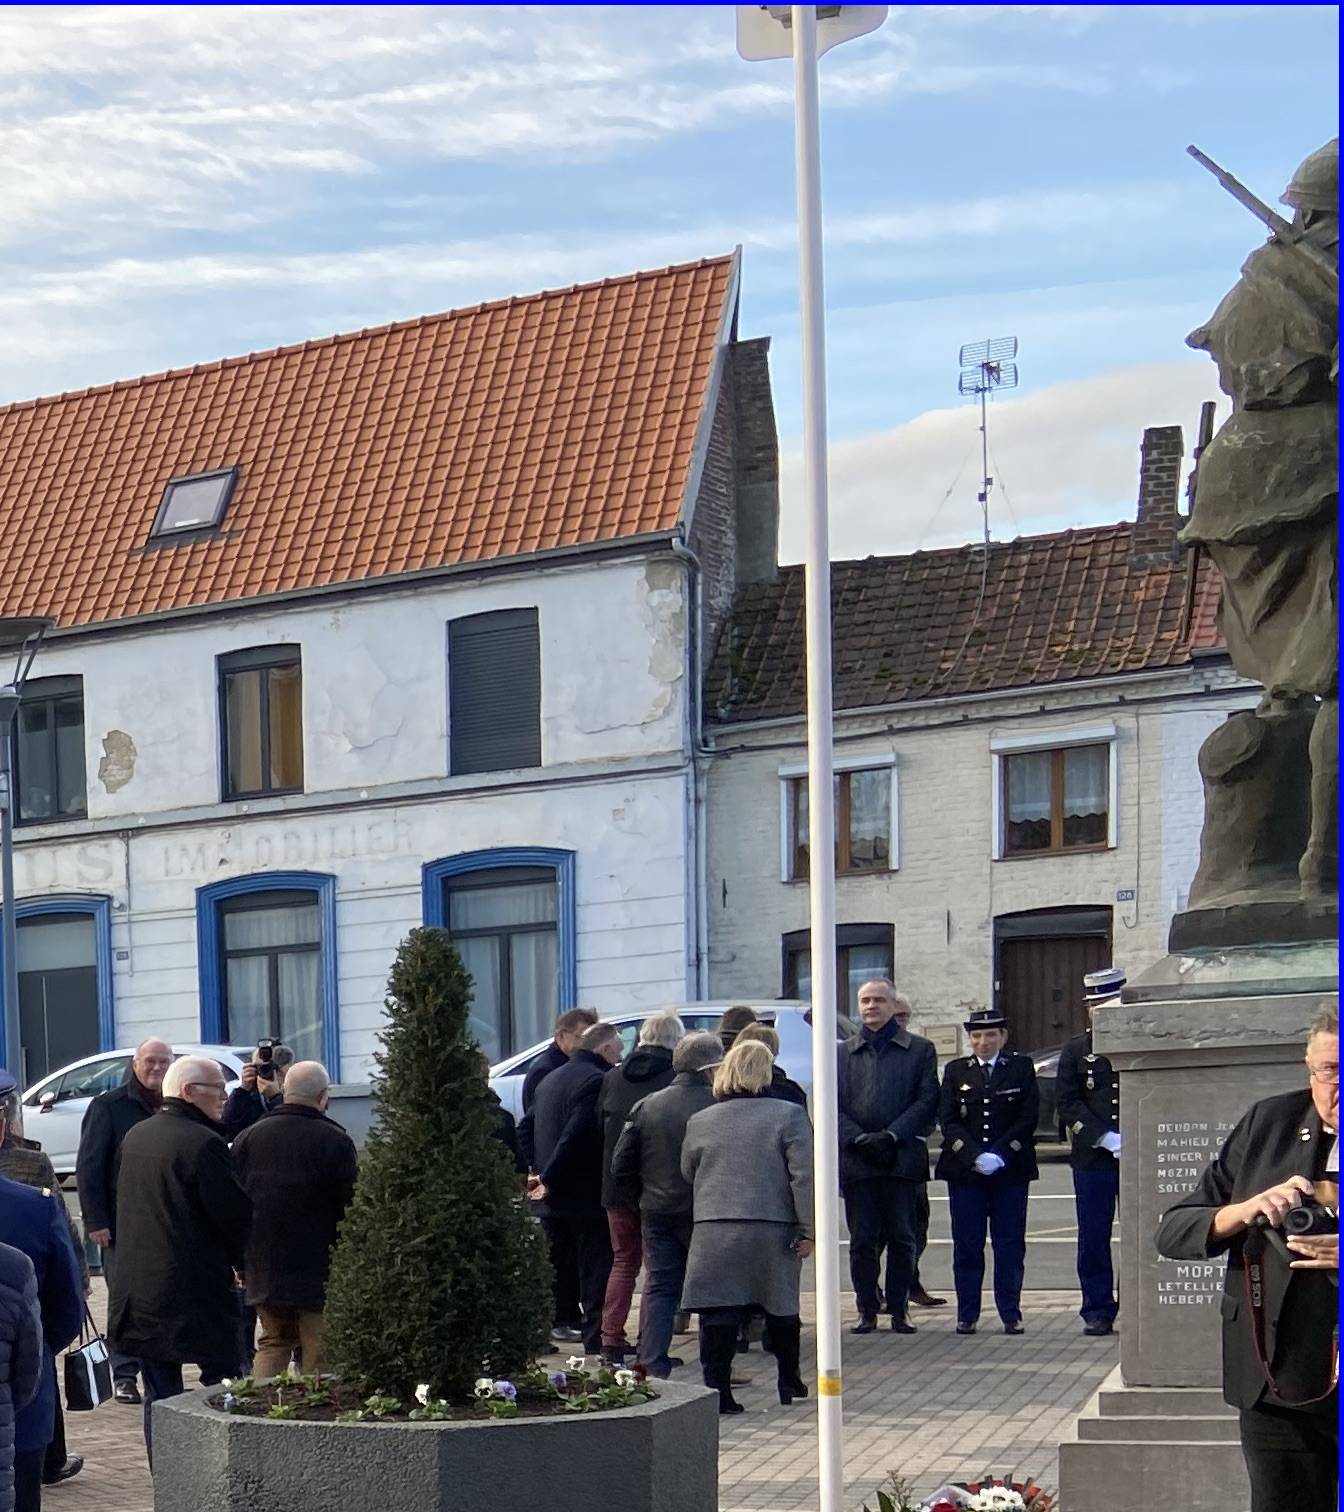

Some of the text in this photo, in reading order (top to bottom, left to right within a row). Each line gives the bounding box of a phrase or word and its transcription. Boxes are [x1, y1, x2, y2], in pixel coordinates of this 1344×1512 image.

[1215, 1121, 1235, 1131] JEA
[1157, 1137, 1210, 1148] MAHIEU
[1157, 1152, 1203, 1163] SINGER
[1158, 1282, 1224, 1292] LETELLIE
[1159, 1294, 1214, 1305] HEBERT
